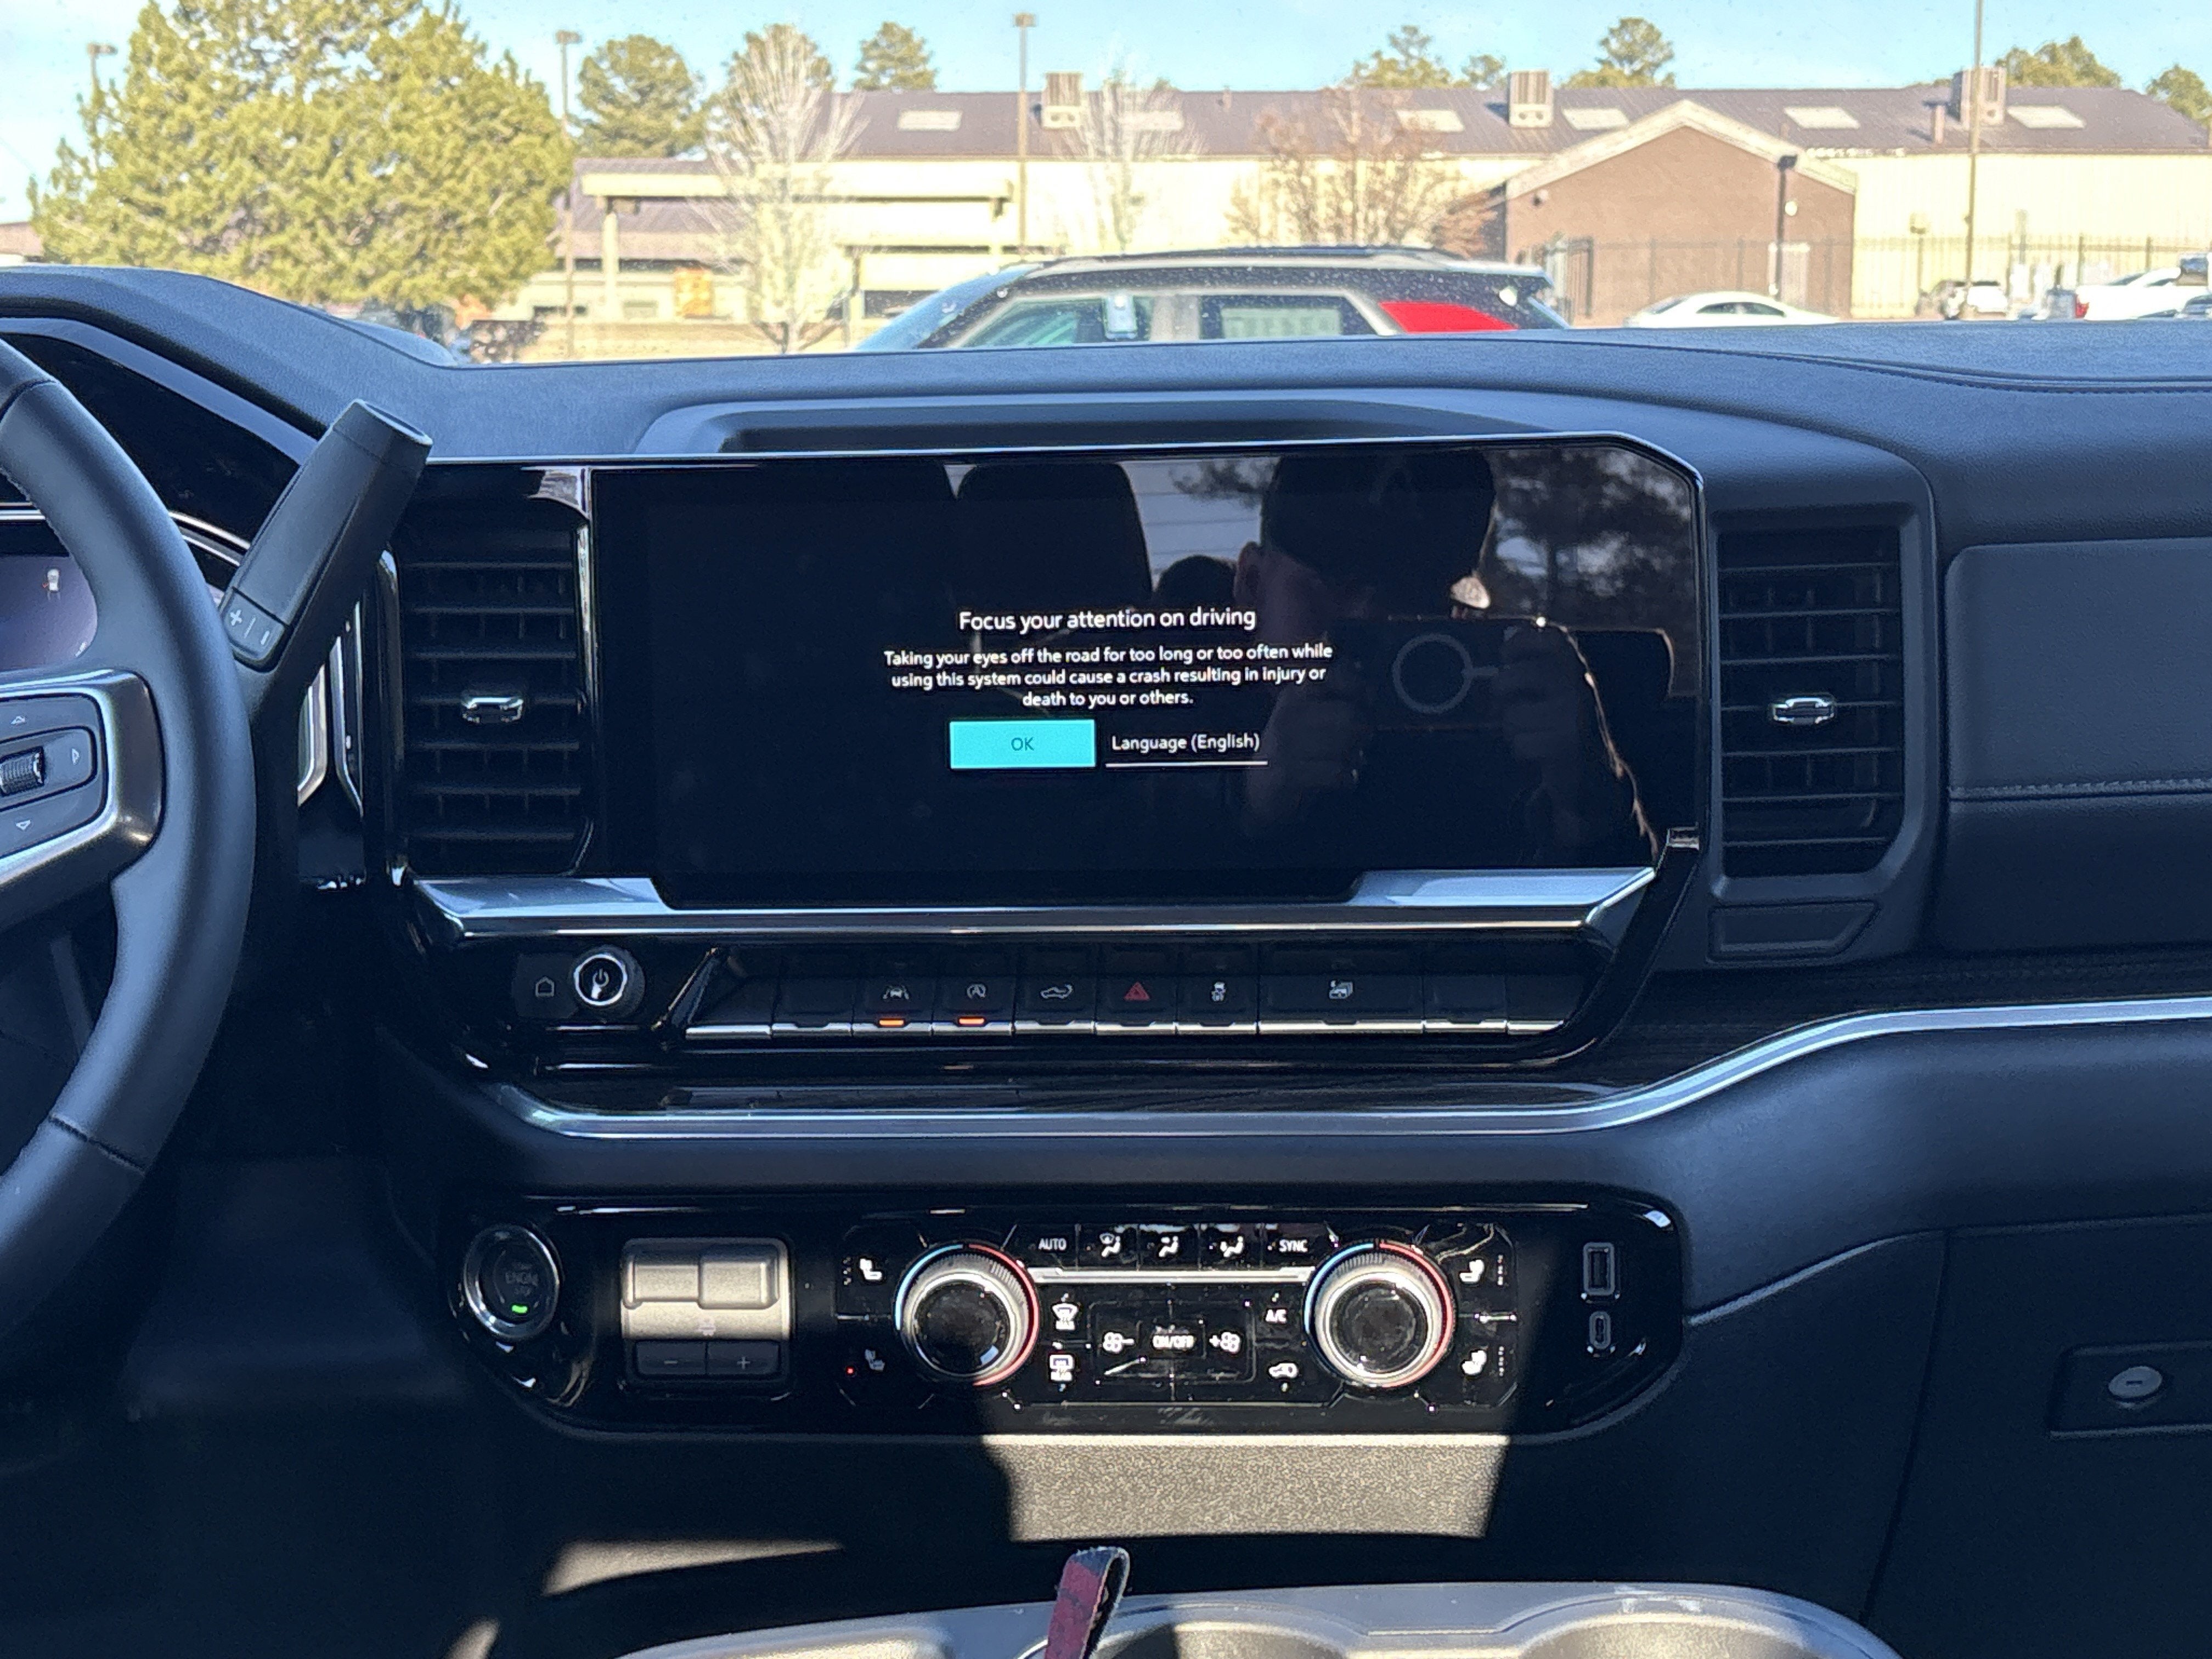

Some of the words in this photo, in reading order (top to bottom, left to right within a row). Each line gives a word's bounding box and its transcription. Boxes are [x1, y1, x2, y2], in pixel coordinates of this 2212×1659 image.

[959, 611, 1016, 630] Focus
[1019, 614, 1063, 635] your
[1066, 609, 1155, 628] attention
[1159, 612, 1184, 627] on
[1189, 606, 1256, 630] driving
[884, 651, 933, 668] Taking
[935, 652, 970, 667] your
[973, 652, 1008, 667] eyes
[1011, 647, 1034, 664] off
[1036, 647, 1062, 663] the
[1065, 647, 1100, 662] road
[1103, 646, 1127, 662] for
[1129, 648, 1155, 662] too
[1159, 646, 1193, 664] long
[1196, 649, 1214, 661] or
[1217, 646, 1244, 660] too
[1246, 643, 1289, 659] often
[1291, 642, 1333, 658] while
[891, 673, 933, 690] using
[935, 671, 964, 687] this
[967, 672, 1021, 690] system
[1024, 669, 1066, 685] could
[1069, 672, 1113, 684] cause
[1116, 672, 1126, 683] a
[1128, 667, 1171, 684] crash
[1173, 666, 1242, 685] resulting
[1244, 666, 1259, 681] in
[1262, 666, 1306, 685] injury
[1308, 668, 1327, 680] or
[1023, 691, 1066, 706] death
[1069, 692, 1086, 706] to
[1088, 694, 1116, 709] you
[1119, 693, 1137, 705] or
[1139, 689, 1194, 705] others.
[1011, 737, 1035, 752] OK
[1113, 735, 1187, 753] Language
[1190, 733, 1260, 752] (English)
[1039, 1238, 1066, 1251] AUTO
[1279, 1239, 1308, 1252] SYNC
[1266, 1310, 1286, 1323] A/C
